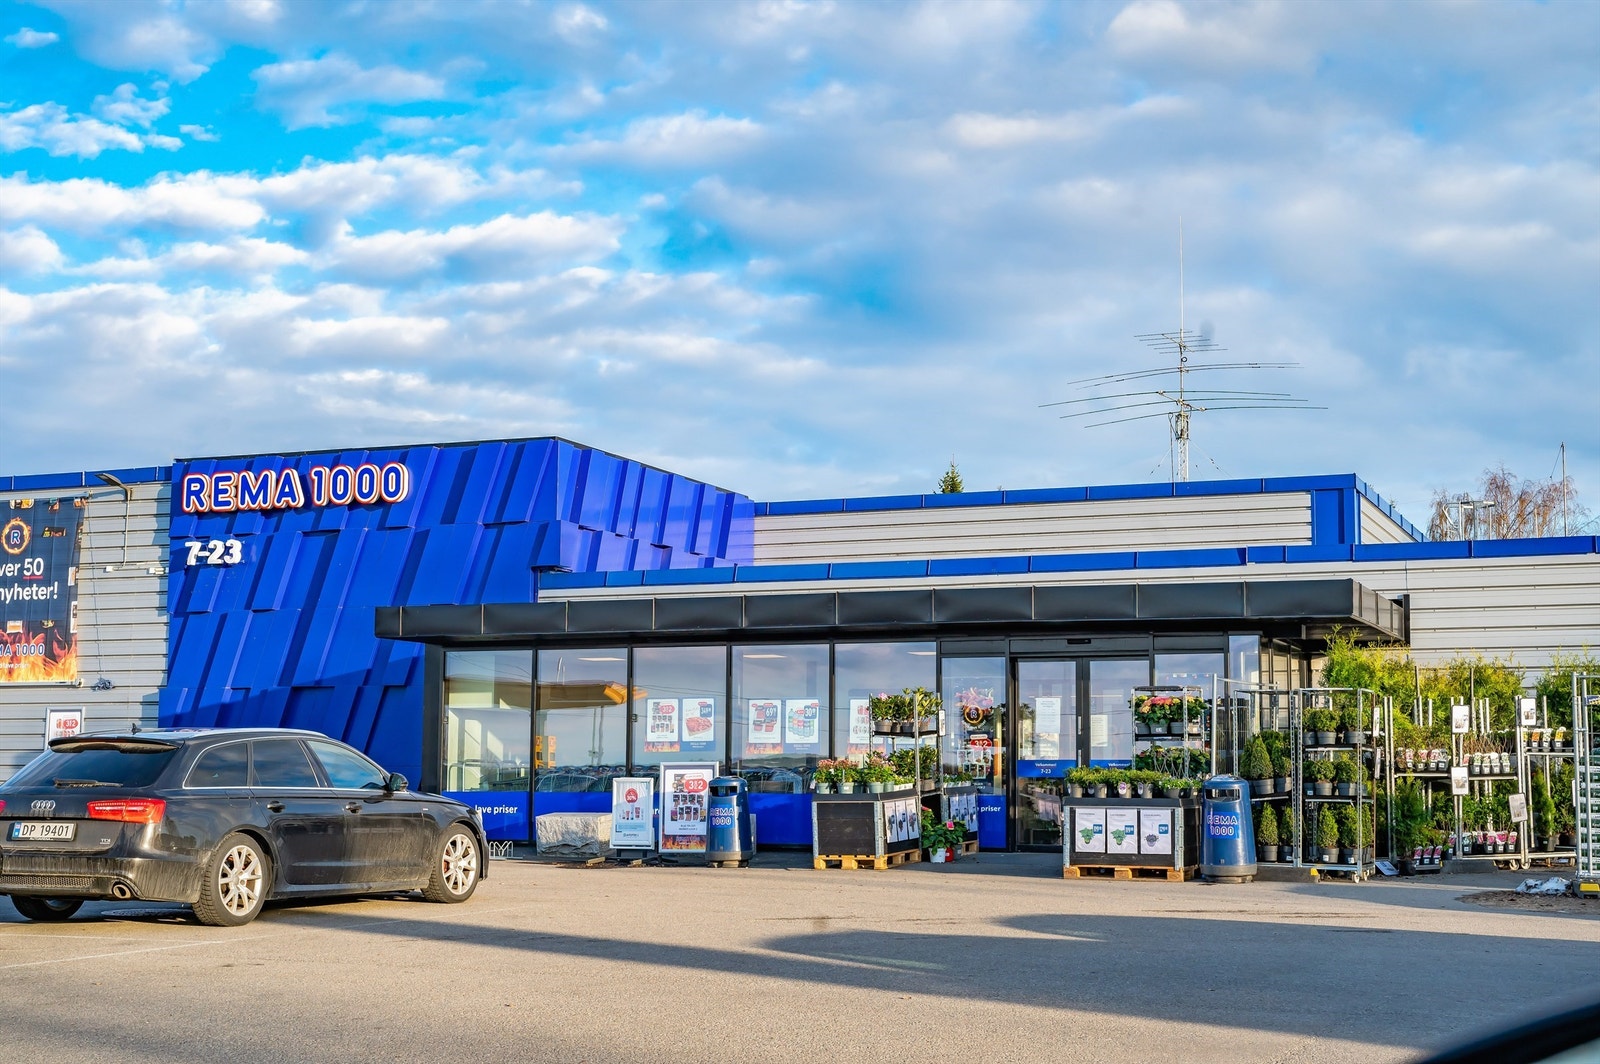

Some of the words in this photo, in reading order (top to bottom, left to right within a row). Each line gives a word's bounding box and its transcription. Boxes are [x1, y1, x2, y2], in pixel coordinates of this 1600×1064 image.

[183, 469, 305, 513] REMA
[310, 462, 409, 506] 1000
[11, 530, 21, 545] R
[185, 539, 243, 566] 7-23
[23, 557, 44, 576] 50
[15, 643, 45, 657] 1000
[494, 804, 518, 815] priser
[712, 816, 732, 826] 1000
[1207, 815, 1237, 825] REMA
[22, 825, 36, 836] DP
[40, 825, 70, 837] 19401
[1210, 826, 1234, 835] 1000
